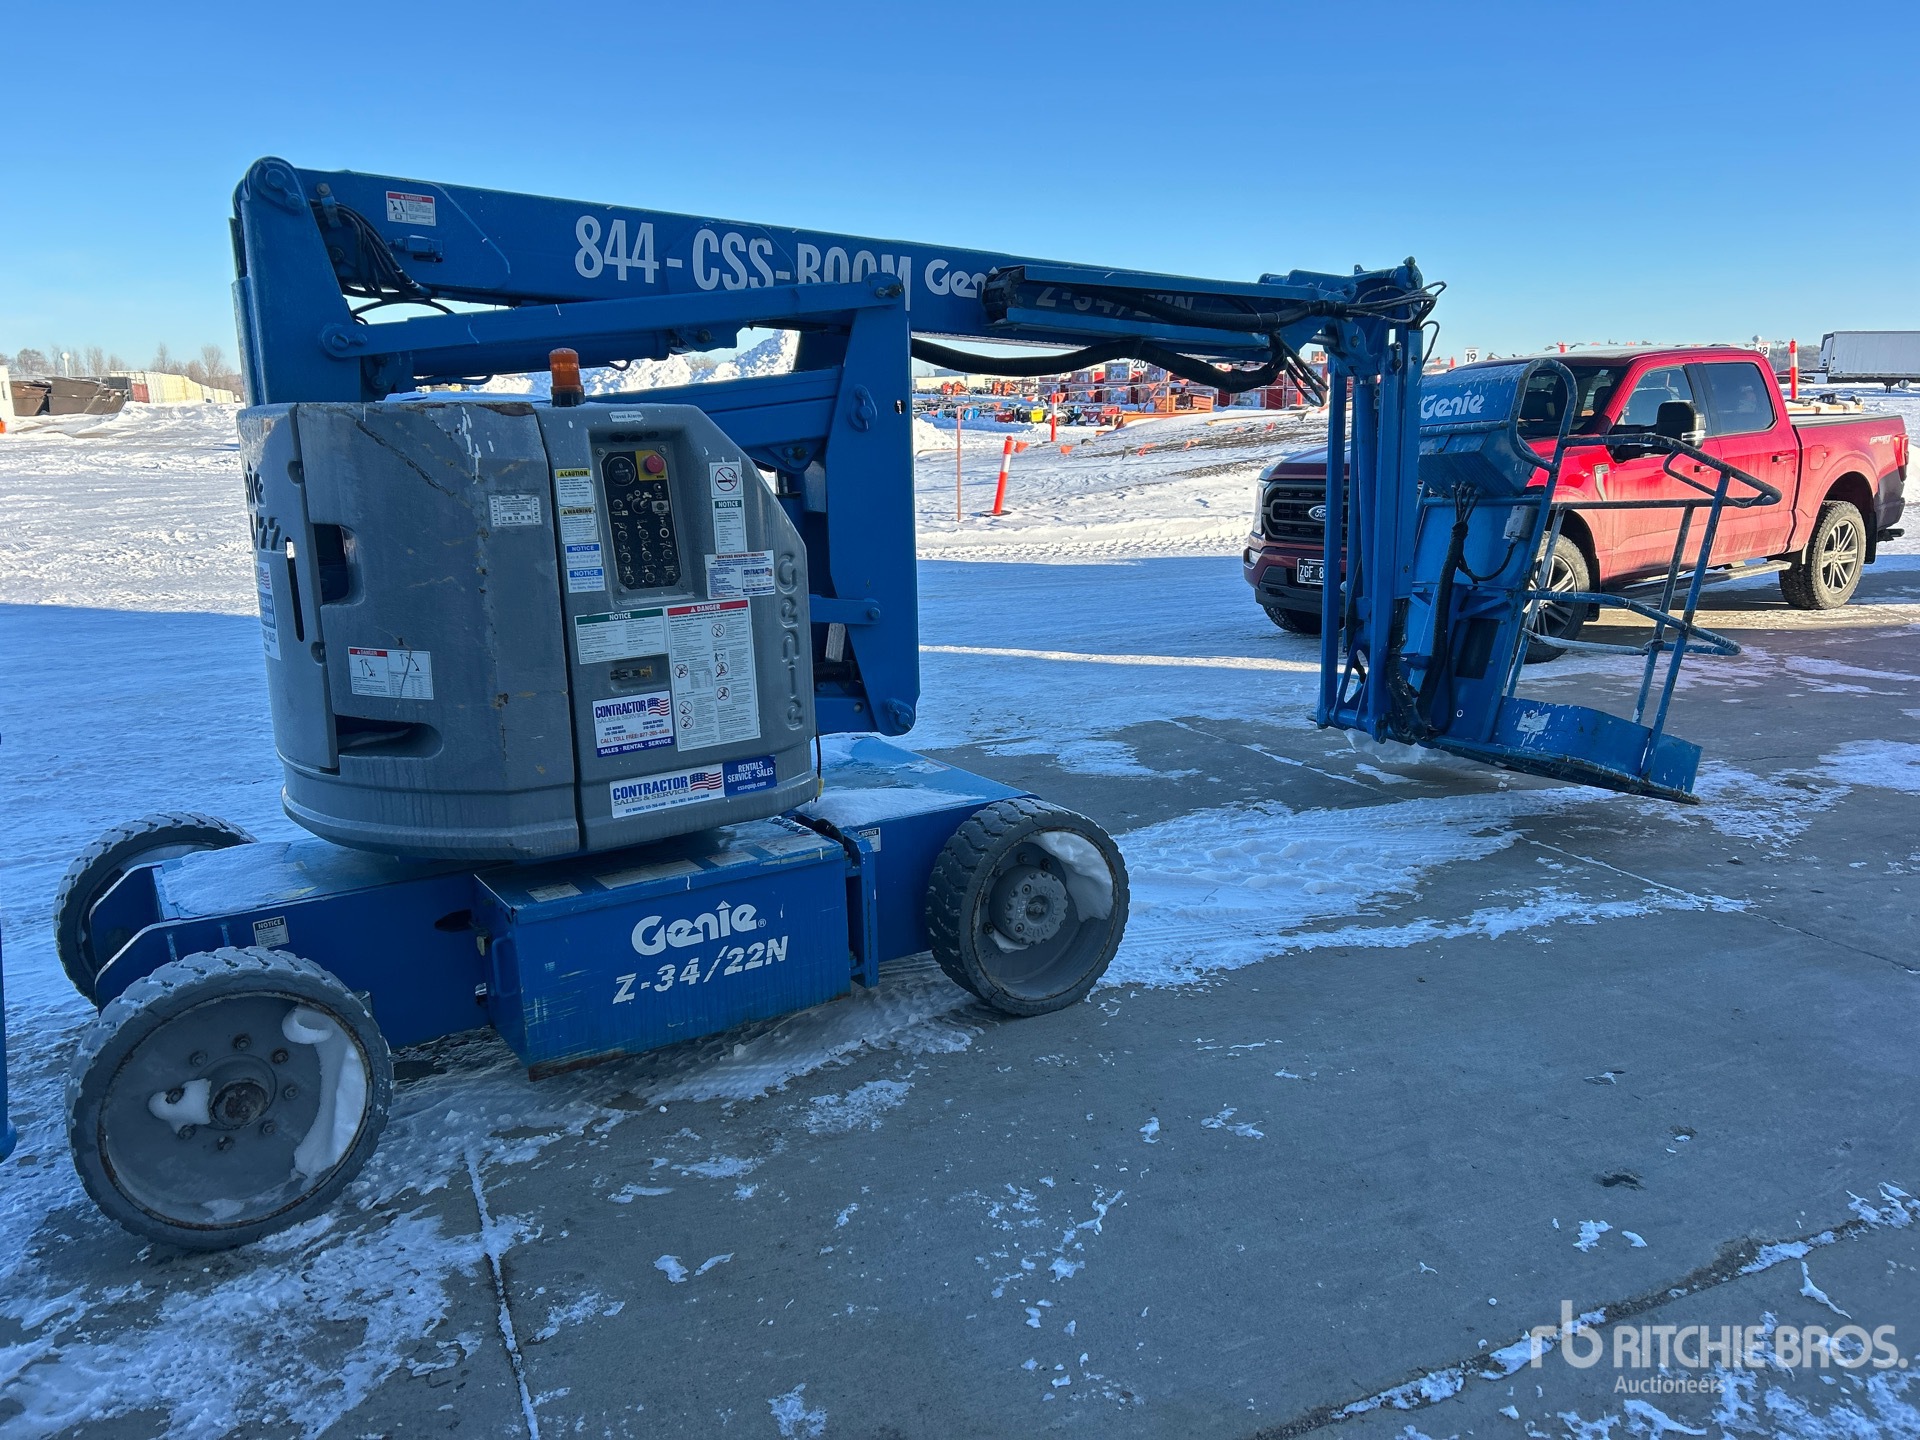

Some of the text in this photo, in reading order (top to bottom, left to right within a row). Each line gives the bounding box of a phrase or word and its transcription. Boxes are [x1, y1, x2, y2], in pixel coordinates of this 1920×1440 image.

[924, 259, 998, 299] Gen
[1466, 353, 1477, 363] 19
[1758, 346, 1769, 356] 18
[1133, 359, 1146, 369] 20
[1420, 389, 1485, 419] Genie
[609, 612, 632, 621] NOTICE
[696, 604, 721, 612] DANGER
[775, 552, 803, 731] Genie
[595, 700, 647, 719] CONTRACTOR
[600, 738, 672, 755] SALES RENTAL SERVICE
[613, 734, 625, 742] TOLL
[727, 771, 752, 783] SERVICE
[756, 766, 774, 778] SALES
[737, 761, 764, 773] RENTALS
[612, 776, 689, 801] CONTRACTOR
[613, 796, 642, 806] SALES
[651, 788, 690, 800] SERVICE
[258, 919, 282, 930] NOTICE
[631, 900, 758, 956] Genie
[612, 936, 789, 1005] Z-34/22N
